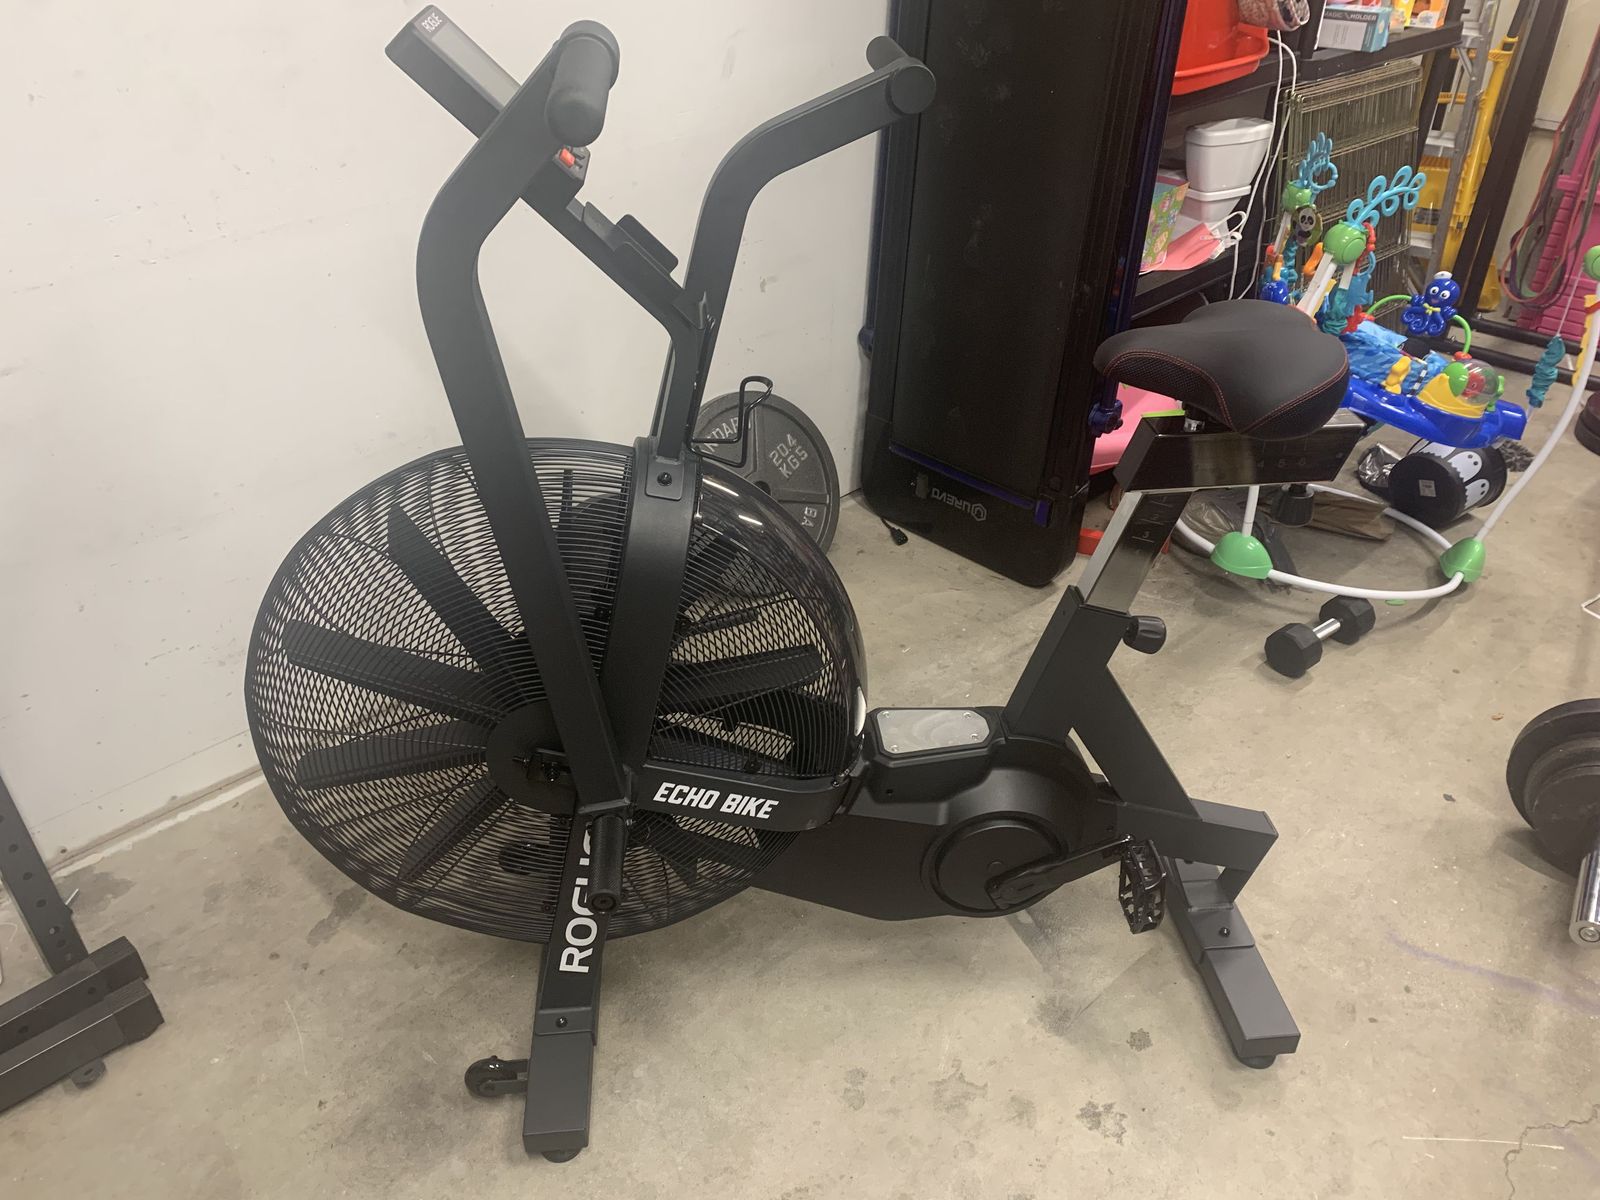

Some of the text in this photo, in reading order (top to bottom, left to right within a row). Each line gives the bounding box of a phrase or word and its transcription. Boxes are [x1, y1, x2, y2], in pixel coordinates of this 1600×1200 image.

[1350, 13, 1377, 21] HOLDER
[769, 433, 797, 467] 20.4
[779, 446, 808, 478] KGS
[931, 487, 970, 513] UREVO
[653, 781, 779, 819] ECHO BIKE
